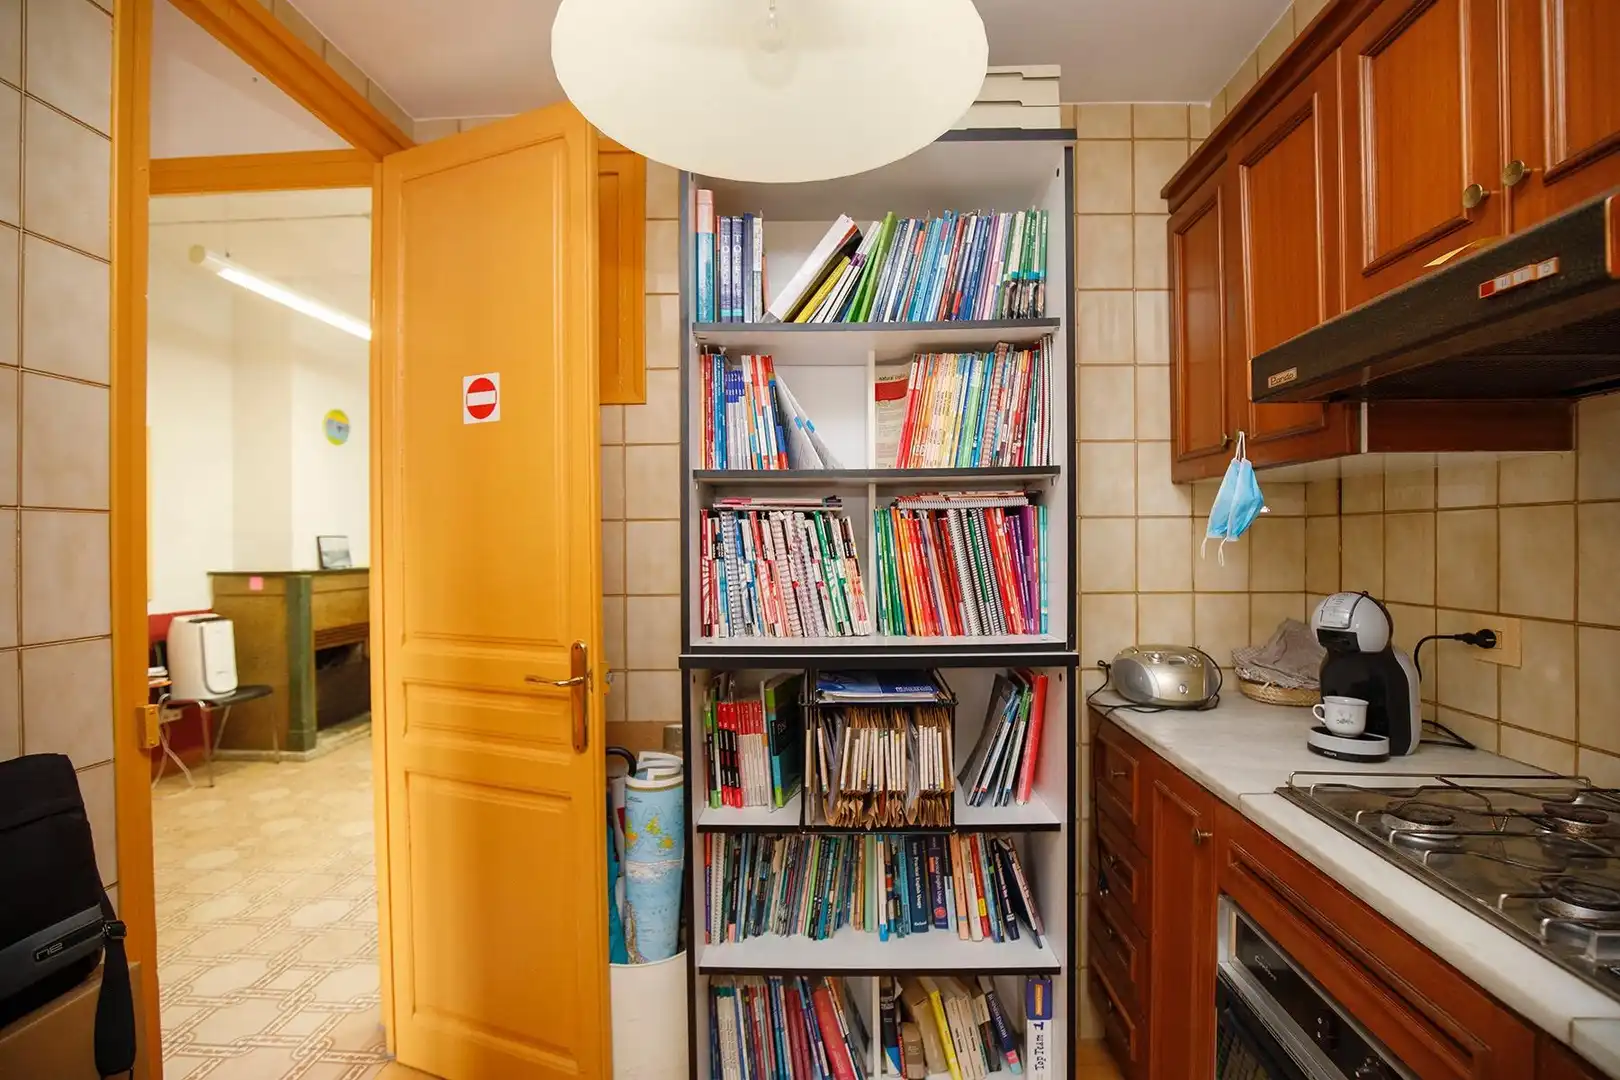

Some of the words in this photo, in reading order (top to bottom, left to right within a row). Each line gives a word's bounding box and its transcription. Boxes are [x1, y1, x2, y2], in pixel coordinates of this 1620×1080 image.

[1033, 1021, 1044, 1031] 1
[1033, 1034, 1044, 1055] Team
[1033, 1056, 1046, 1071] Top
